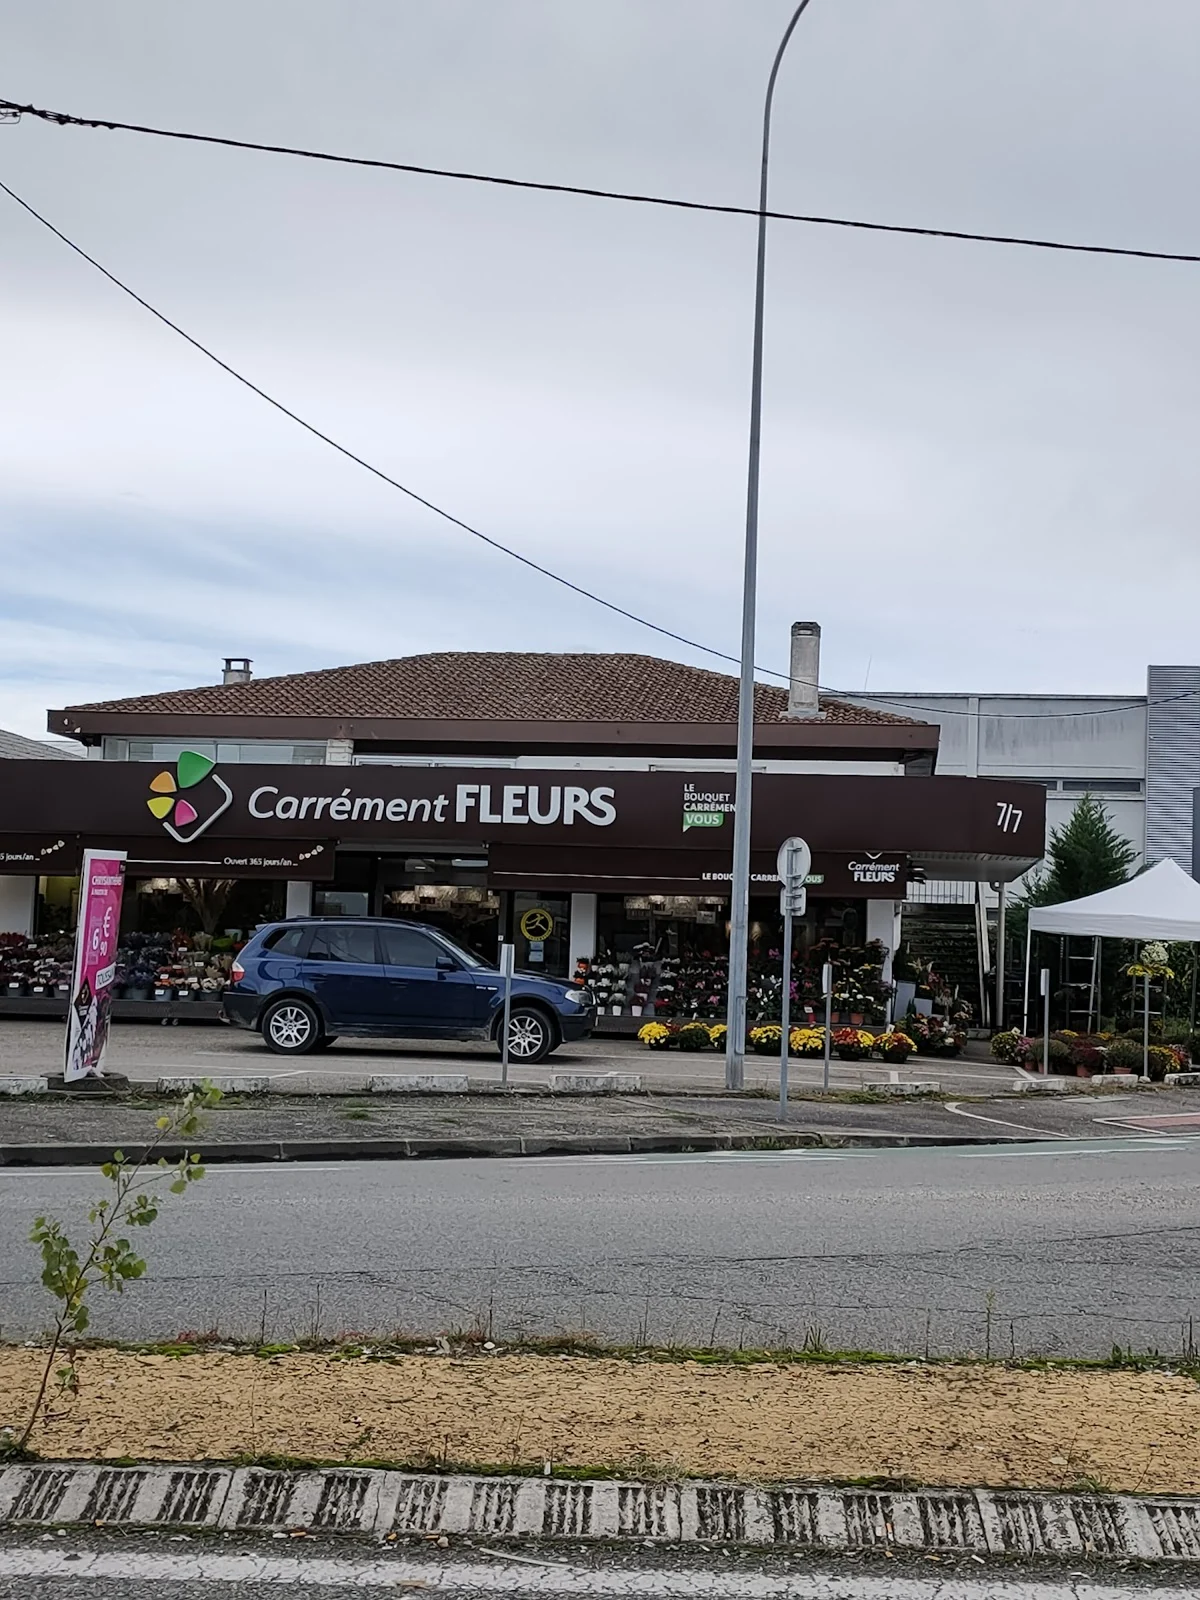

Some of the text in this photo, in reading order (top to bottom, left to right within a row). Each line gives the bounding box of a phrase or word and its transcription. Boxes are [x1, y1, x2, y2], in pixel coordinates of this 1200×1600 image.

[683, 783, 695, 792] LE
[683, 792, 731, 802] BOUQUET
[248, 784, 617, 826] Carrément FLEURS
[683, 802, 736, 812] CARRÉMEN
[685, 813, 720, 825] VOUS
[996, 802, 1023, 833] 7/7
[223, 856, 248, 866] Ouvert
[249, 857, 263, 866] 365
[847, 860, 900, 871] Carrément
[701, 872, 712, 880] LE
[805, 874, 822, 883] OUS
[853, 871, 896, 882] FLEURS
